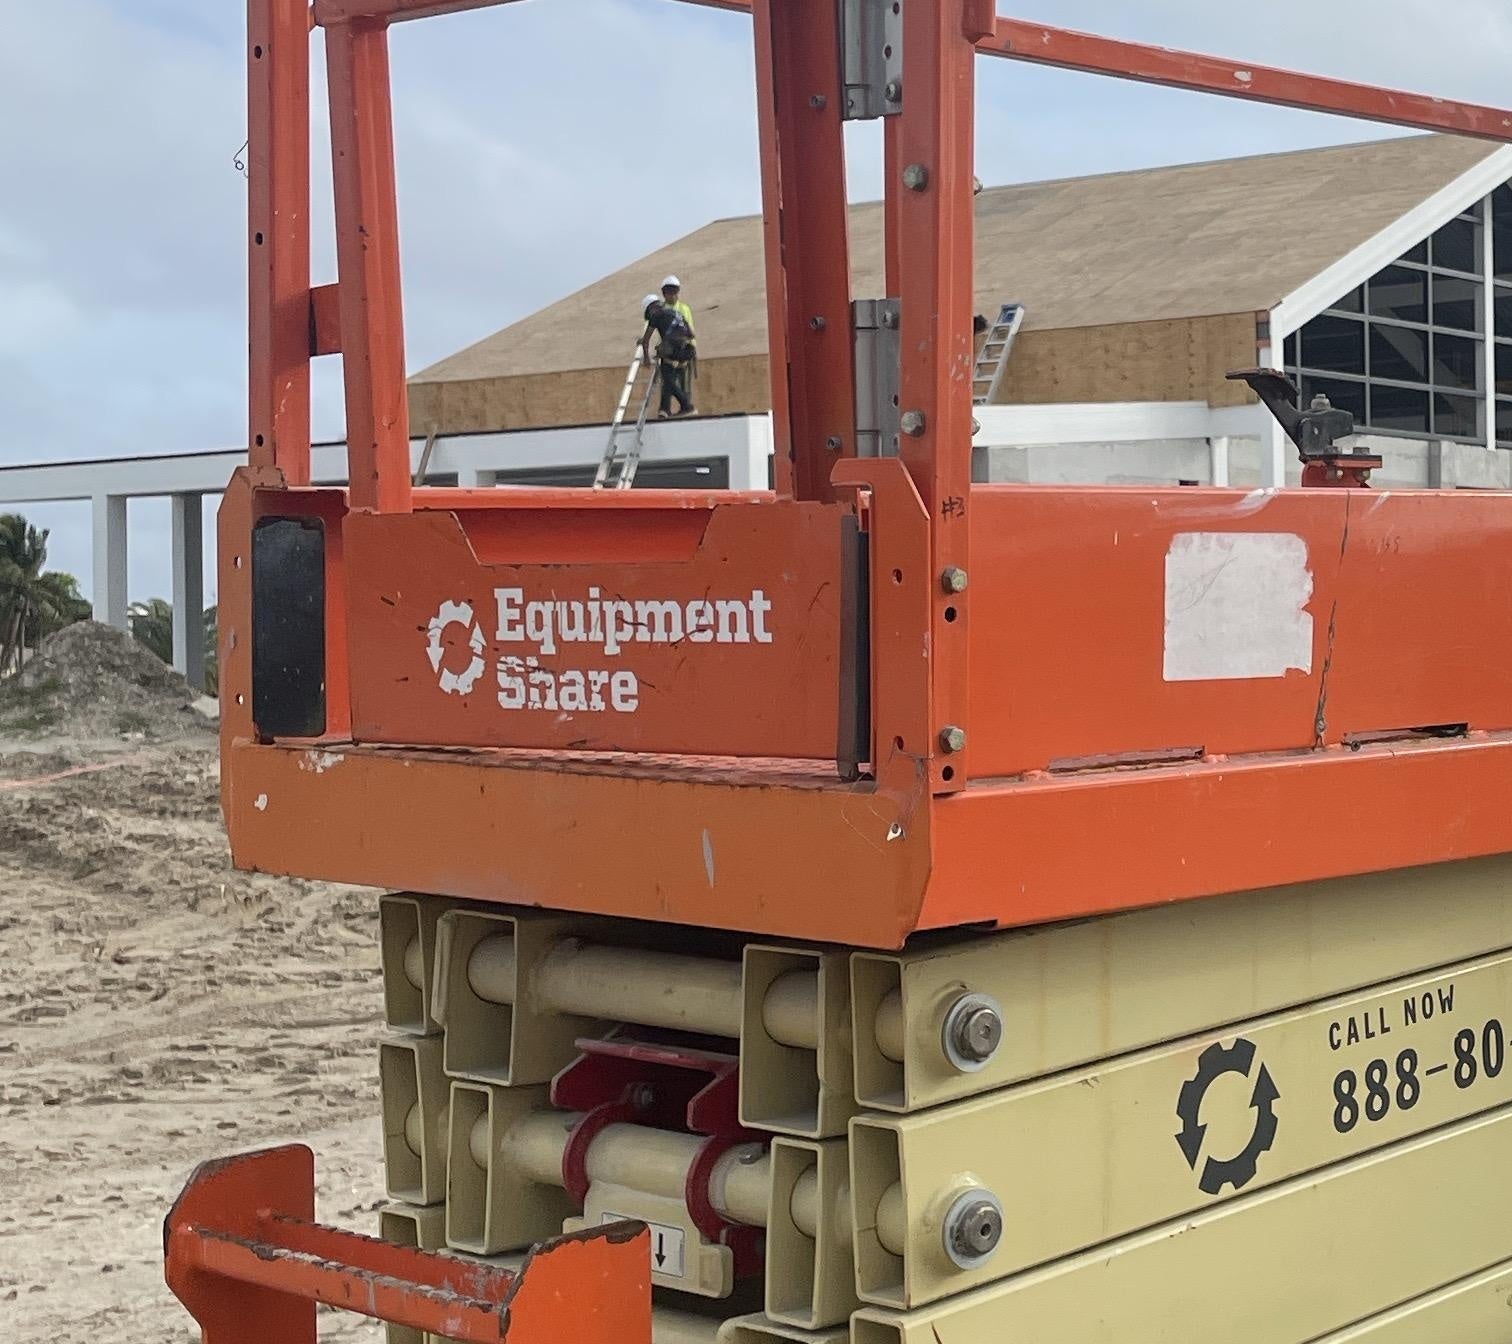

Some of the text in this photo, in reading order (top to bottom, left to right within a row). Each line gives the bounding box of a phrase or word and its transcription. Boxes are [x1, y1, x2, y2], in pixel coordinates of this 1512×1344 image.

[493, 586, 773, 656] Equipment
[497, 656, 640, 713] Share
[1328, 984, 1455, 1051] CALL NOW
